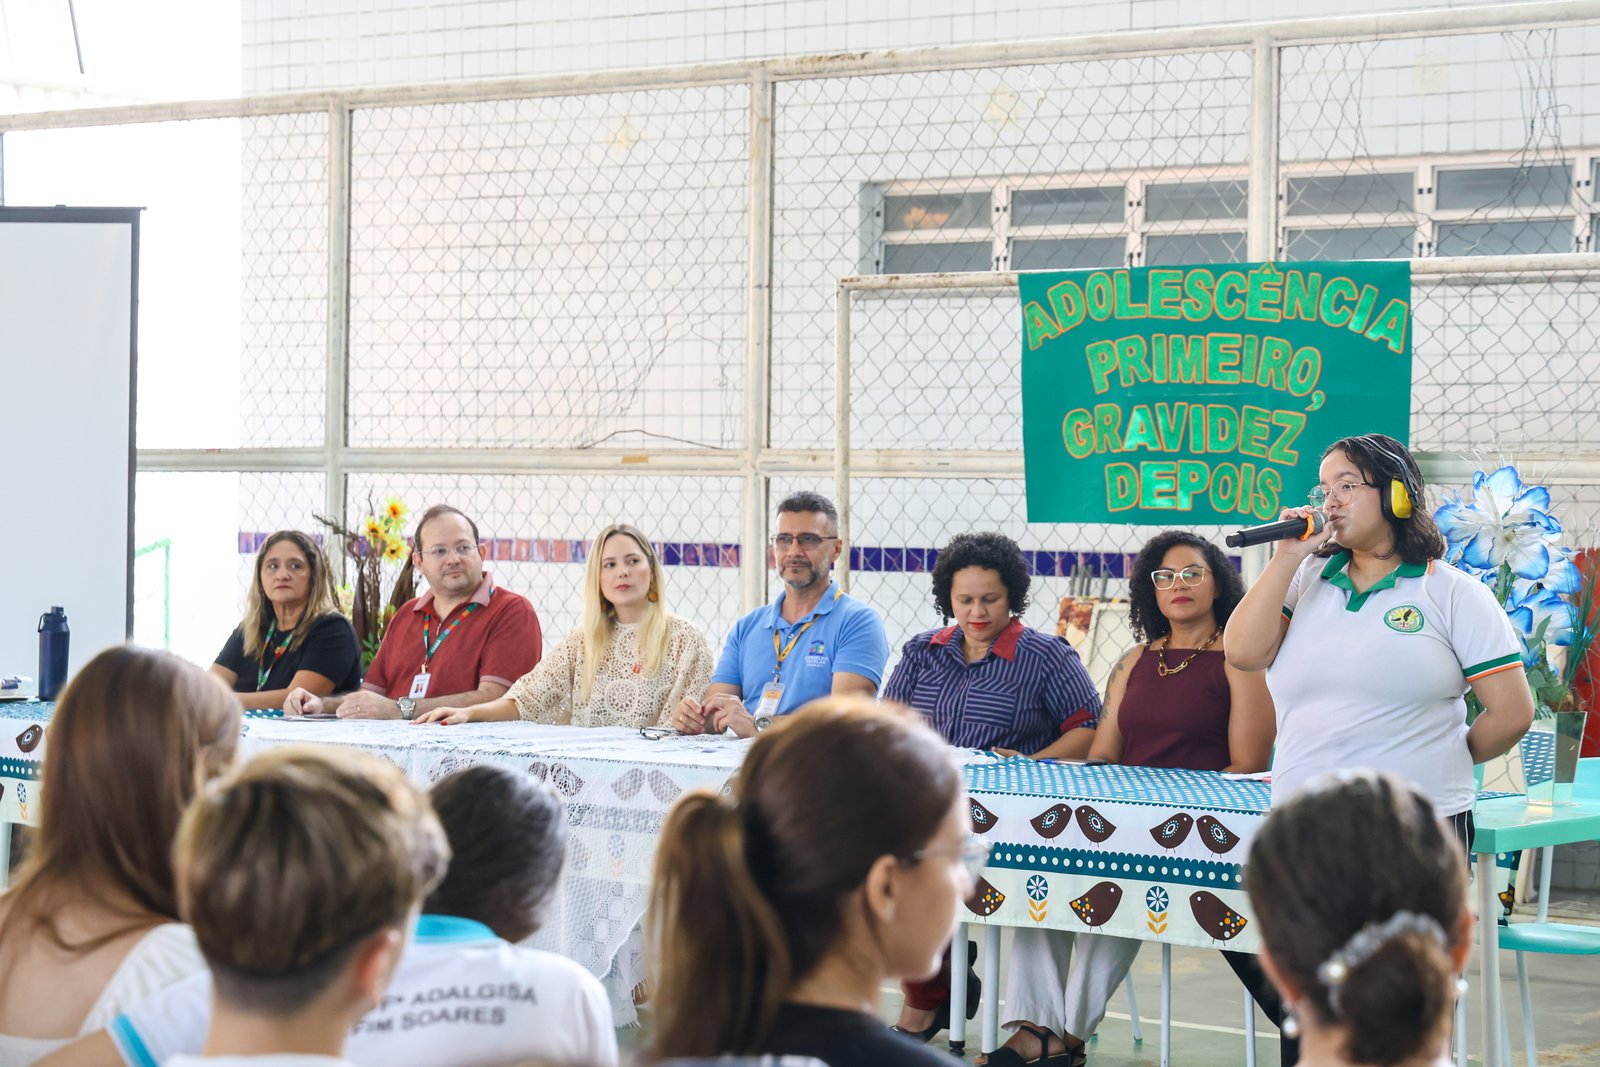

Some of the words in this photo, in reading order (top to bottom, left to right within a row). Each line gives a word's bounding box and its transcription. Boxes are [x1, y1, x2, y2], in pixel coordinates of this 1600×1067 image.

[1023, 260, 1410, 354] ADOLESCÊNCIA
[1085, 332, 1325, 411] PRIMEIRO,
[1062, 401, 1307, 467] GRAVIDEZ
[401, 1006, 505, 1030] SOARES
[411, 983, 537, 1005] ADALGISA
